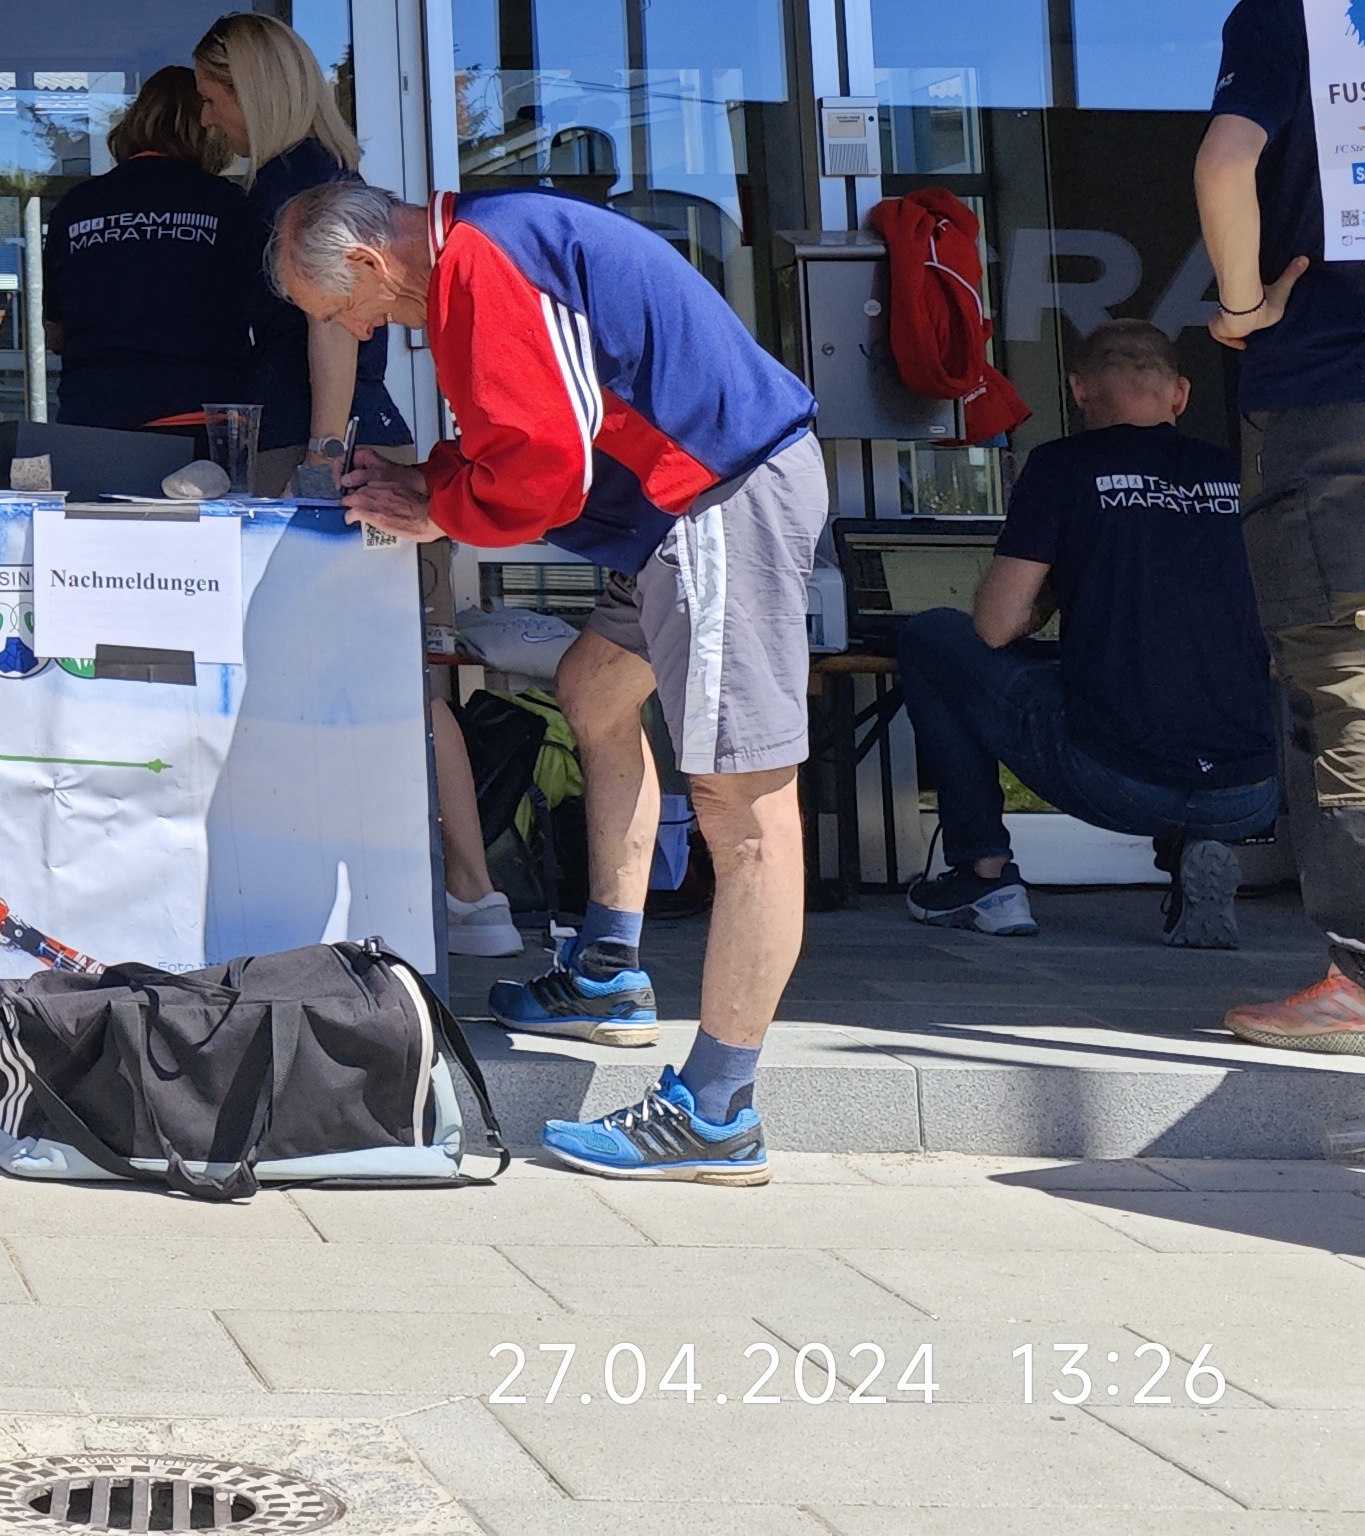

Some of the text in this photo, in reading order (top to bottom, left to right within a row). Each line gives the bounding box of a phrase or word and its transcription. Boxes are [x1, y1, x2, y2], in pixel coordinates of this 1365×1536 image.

[106, 211, 170, 228] TEAM
[69, 225, 217, 255] MARATHON
[1143, 474, 1204, 499] TEAM
[50, 569, 220, 596] Nachmeldungen
